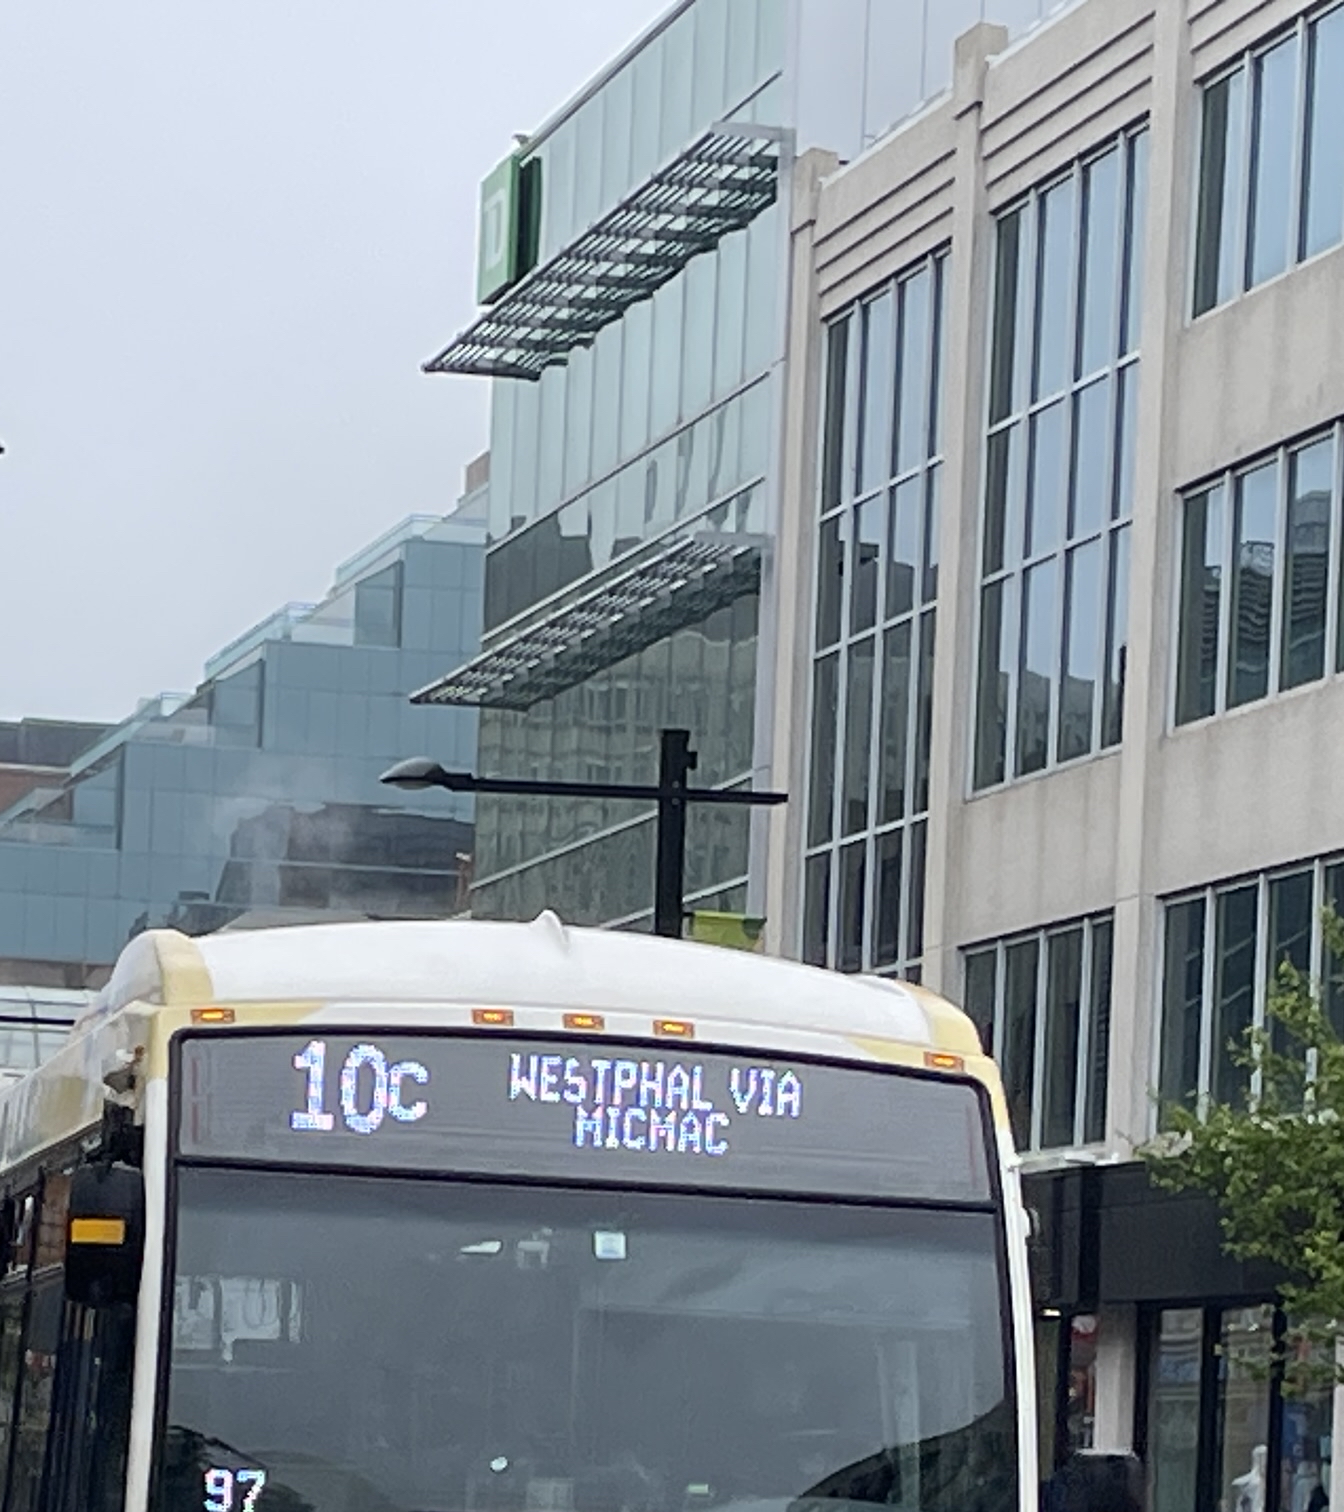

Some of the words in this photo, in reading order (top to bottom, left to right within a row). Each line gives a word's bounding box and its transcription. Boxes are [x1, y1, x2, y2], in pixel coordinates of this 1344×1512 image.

[290, 1040, 429, 1134] 10C
[509, 1053, 714, 1111] WESTPHAL
[729, 1068, 803, 1118] VIA
[575, 1104, 730, 1155] MICMAC
